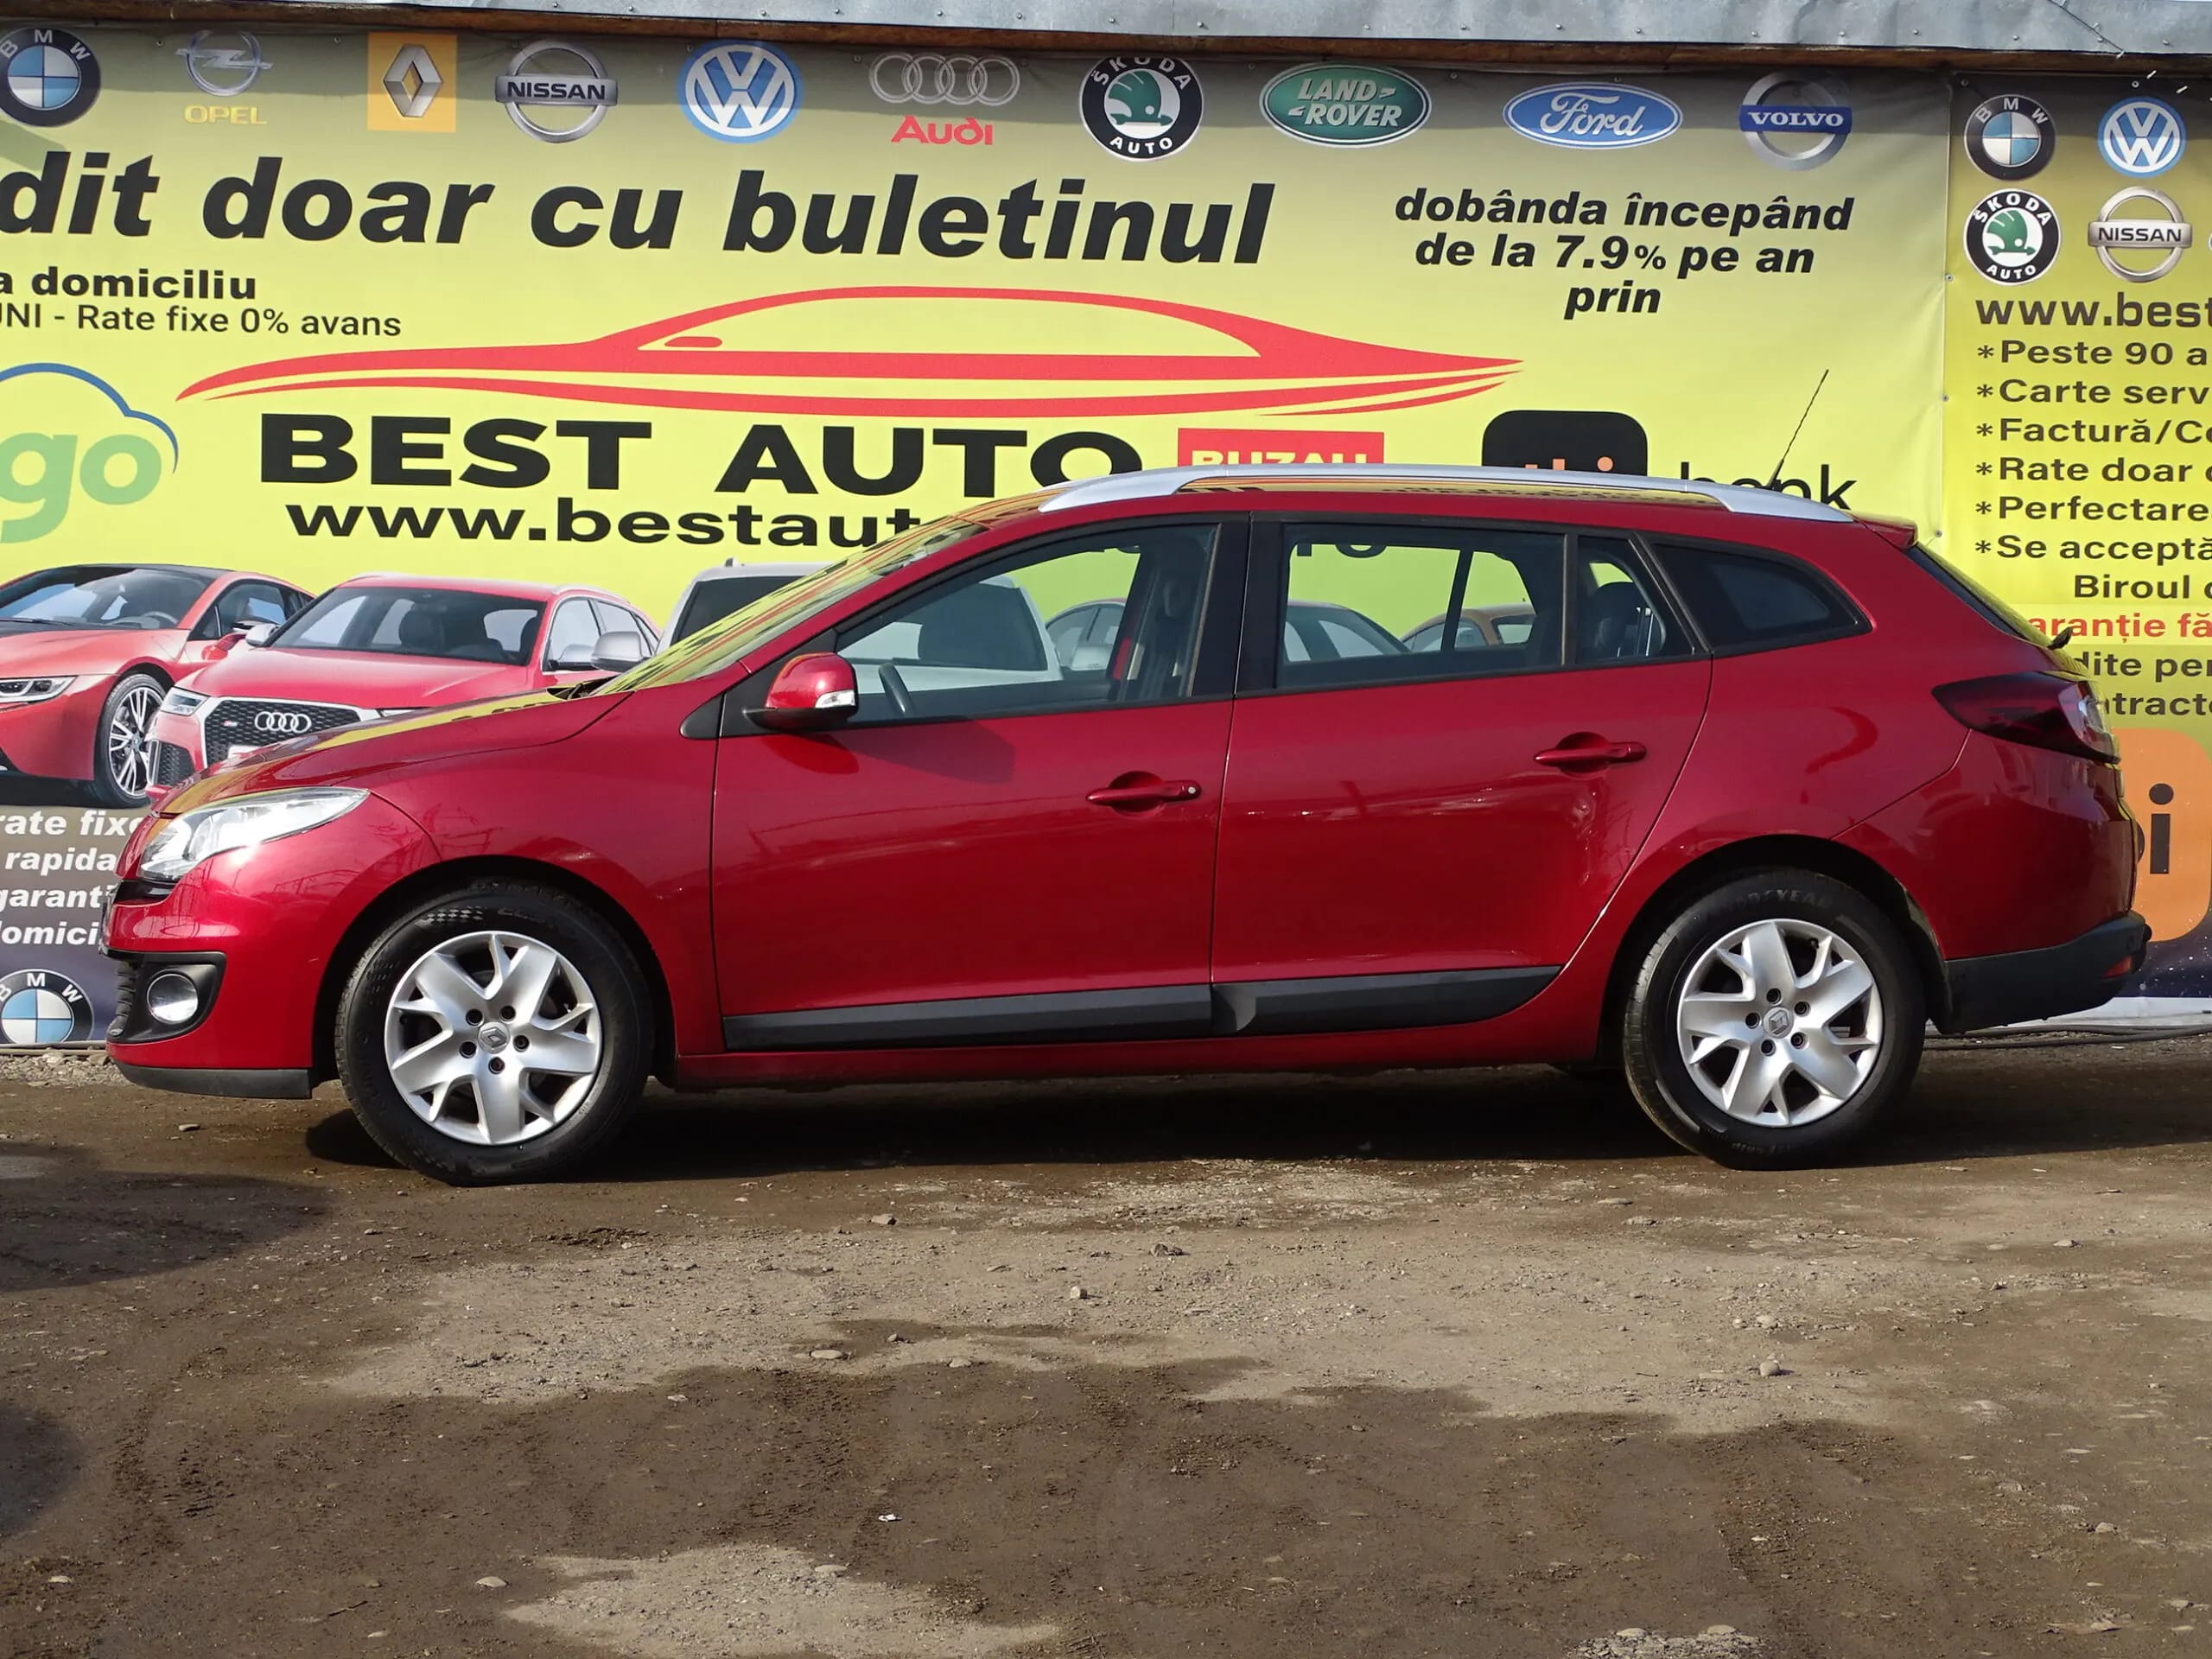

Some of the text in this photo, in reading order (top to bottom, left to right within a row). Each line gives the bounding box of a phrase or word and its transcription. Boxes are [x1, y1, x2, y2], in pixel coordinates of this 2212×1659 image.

[0, 29, 91, 60] BMW
[506, 80, 605, 101] NISSAN
[1298, 79, 1377, 101] LAND
[184, 105, 268, 125] OPEL
[1305, 104, 1402, 127] ROVER
[1539, 92, 1645, 137] Ford
[1747, 111, 1845, 128] VOLVO
[1974, 97, 2050, 124] BMW
[891, 115, 993, 145] Audi
[1109, 136, 1173, 155] AUTO
[0, 150, 1275, 264] dit doar cu buletinul
[1395, 188, 1856, 237] dobânda începând
[2098, 227, 2183, 243] NISSAN
[1415, 232, 1815, 280] de la 7.9% pe an
[31, 266, 257, 300] domiciliu
[1986, 264, 2037, 281] AUTO
[1563, 279, 1662, 321] prin
[0, 302, 41, 327] NI
[78, 303, 156, 332] Rate
[166, 306, 229, 334] fixe
[239, 308, 289, 334] 0%
[301, 313, 402, 337] avans
[2125, 342, 2173, 365] 90
[2186, 347, 2208, 365] a
[2123, 385, 2209, 404] serv
[1976, 417, 2212, 445] Factură/C
[261, 412, 1143, 499] BEST AUTO
[2101, 457, 2193, 482] doar
[2074, 574, 2190, 599] Biroul
[2105, 693, 2212, 716] tract
[4, 847, 117, 876] rapida
[0, 920, 100, 946] omici
[0, 972, 83, 1003] BMW
